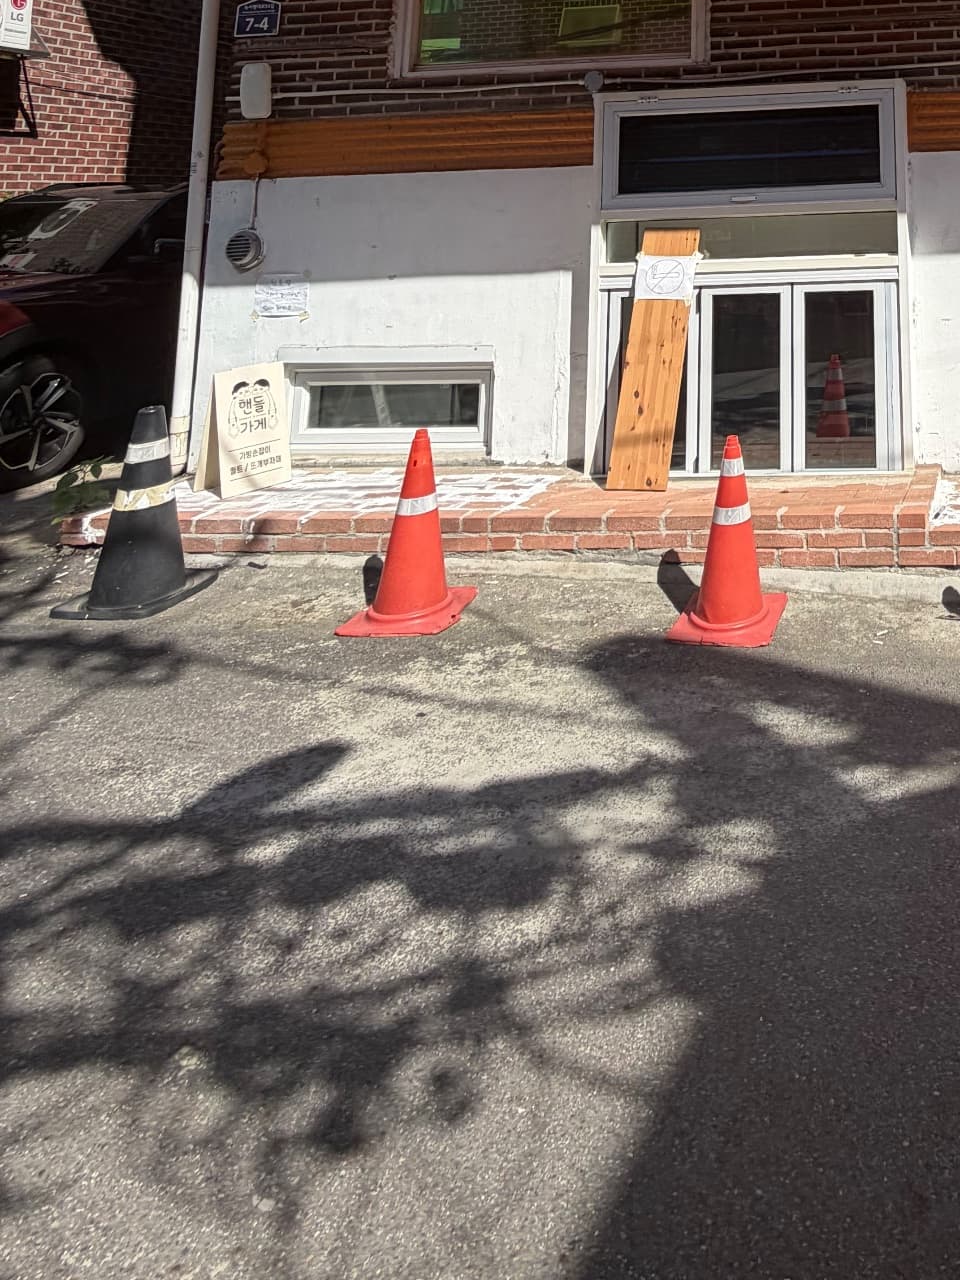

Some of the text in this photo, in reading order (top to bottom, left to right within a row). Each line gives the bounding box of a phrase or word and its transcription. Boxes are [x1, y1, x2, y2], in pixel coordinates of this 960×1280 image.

[10, 11, 24, 23] LG
[245, 16, 269, 32] 7-4
[238, 395, 265, 415] 핸들
[240, 417, 267, 433] 가게
